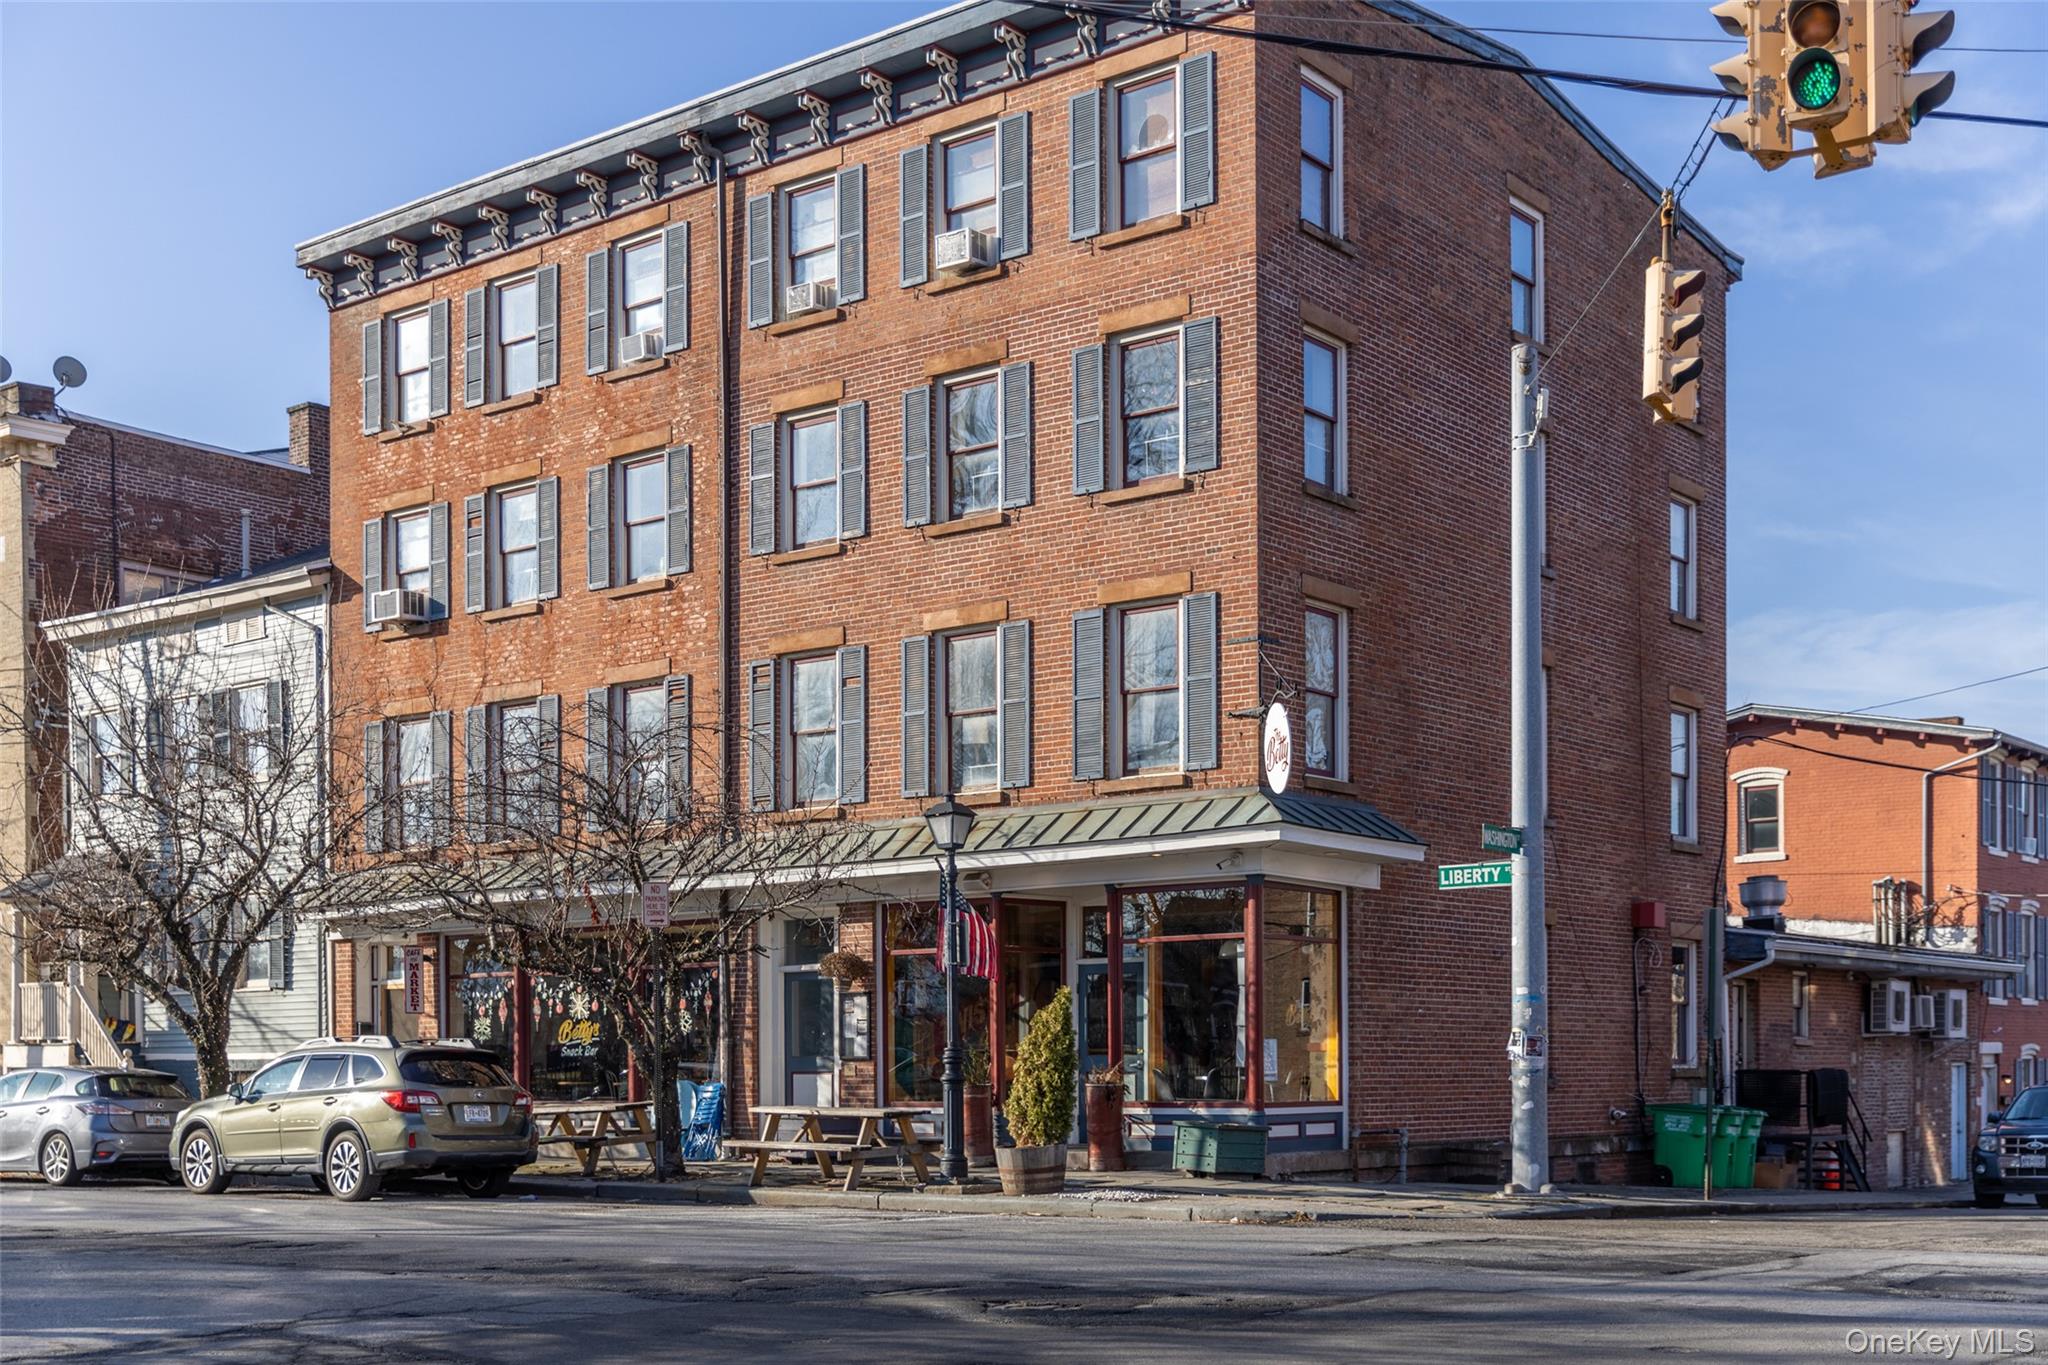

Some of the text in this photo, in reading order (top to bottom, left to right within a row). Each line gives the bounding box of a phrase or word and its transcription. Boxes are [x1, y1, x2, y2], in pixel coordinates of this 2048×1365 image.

[1266, 736, 1289, 772] Betty
[1484, 830, 1518, 849] WASHINGTON
[1440, 867, 1501, 885] LIBERTY
[645, 895, 667, 903] PARKING
[650, 885, 661, 895] NO
[409, 963, 420, 1011] MARKET
[558, 1018, 600, 1046] Betty's
[561, 1045, 599, 1057] Snack Bar
